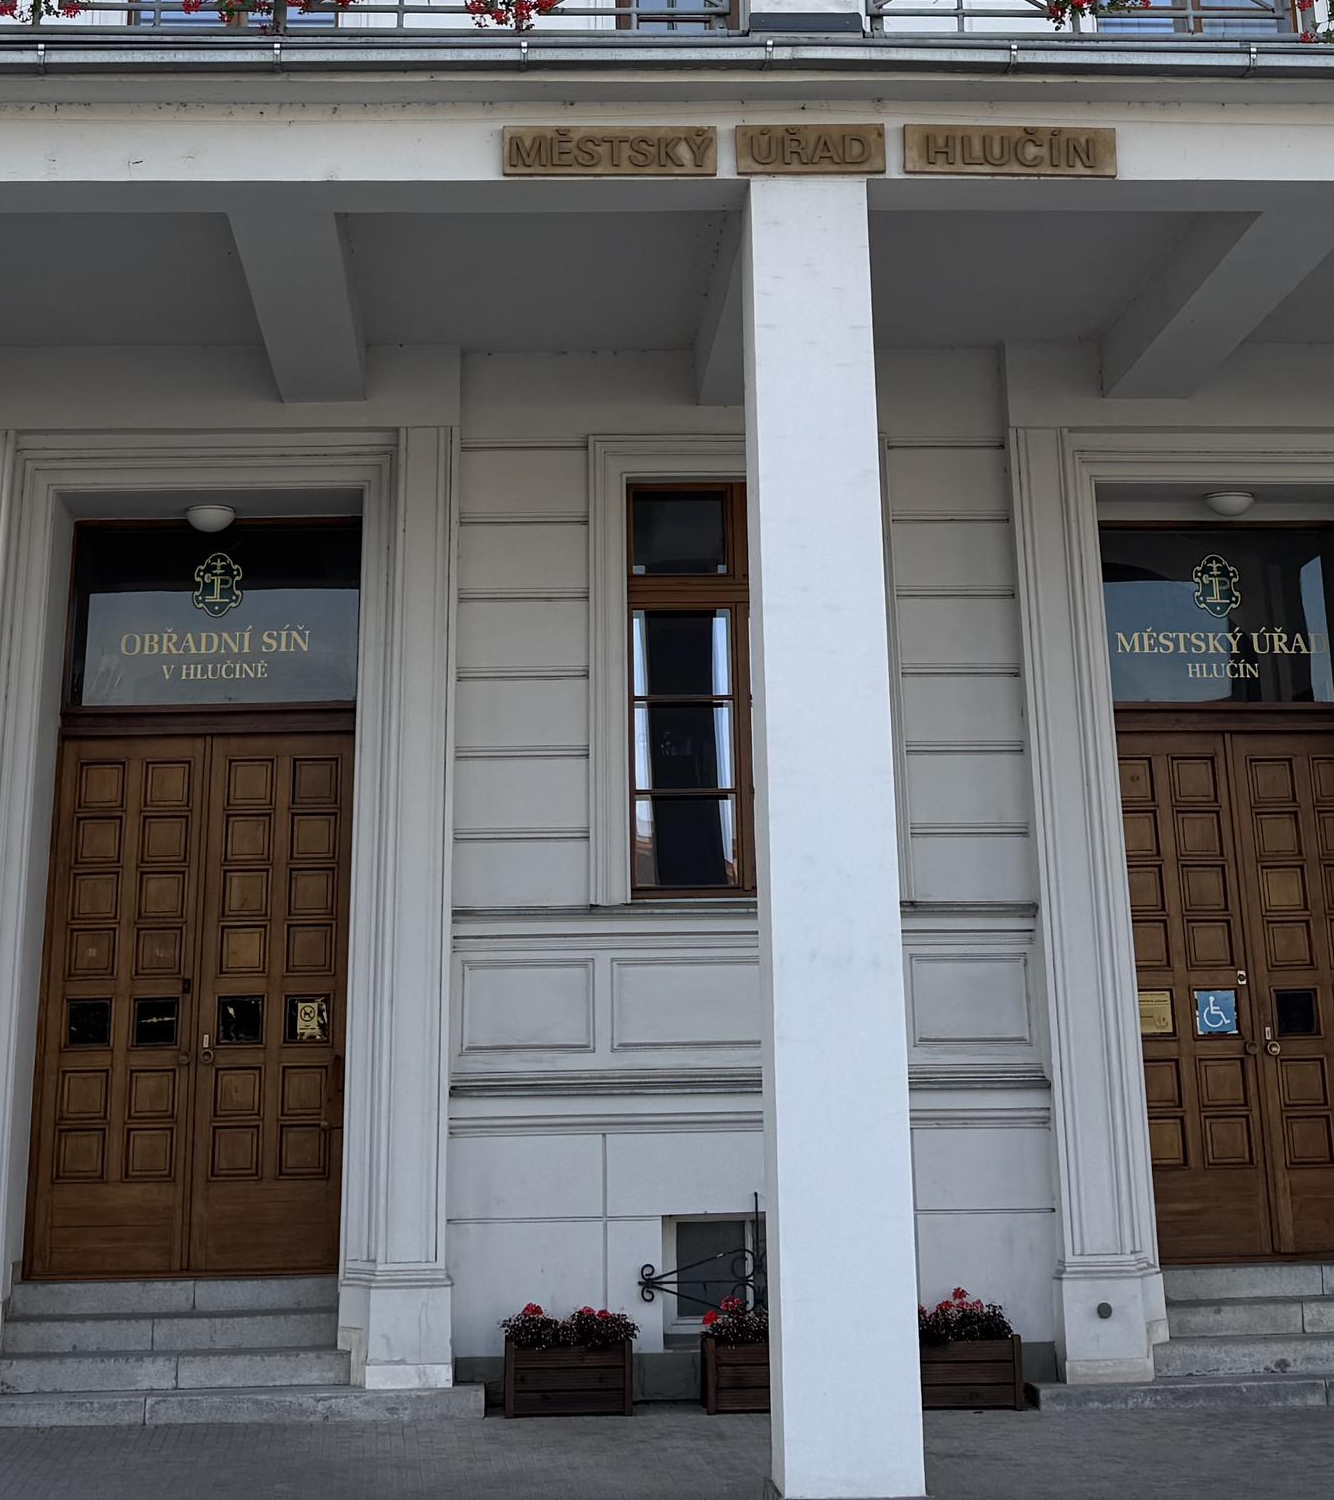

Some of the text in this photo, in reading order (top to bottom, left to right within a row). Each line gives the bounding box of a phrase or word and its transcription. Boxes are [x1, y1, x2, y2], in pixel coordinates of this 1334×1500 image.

[508, 127, 1097, 169] MĚSTSKÝ ÚŘAD HLUČÍN
[120, 624, 312, 656] OBŘADNÍ SÍŇ
[1115, 627, 1243, 655] MĚSTSKÝ
[162, 664, 175, 680] V
[1187, 659, 1259, 679] HLUČÍN
